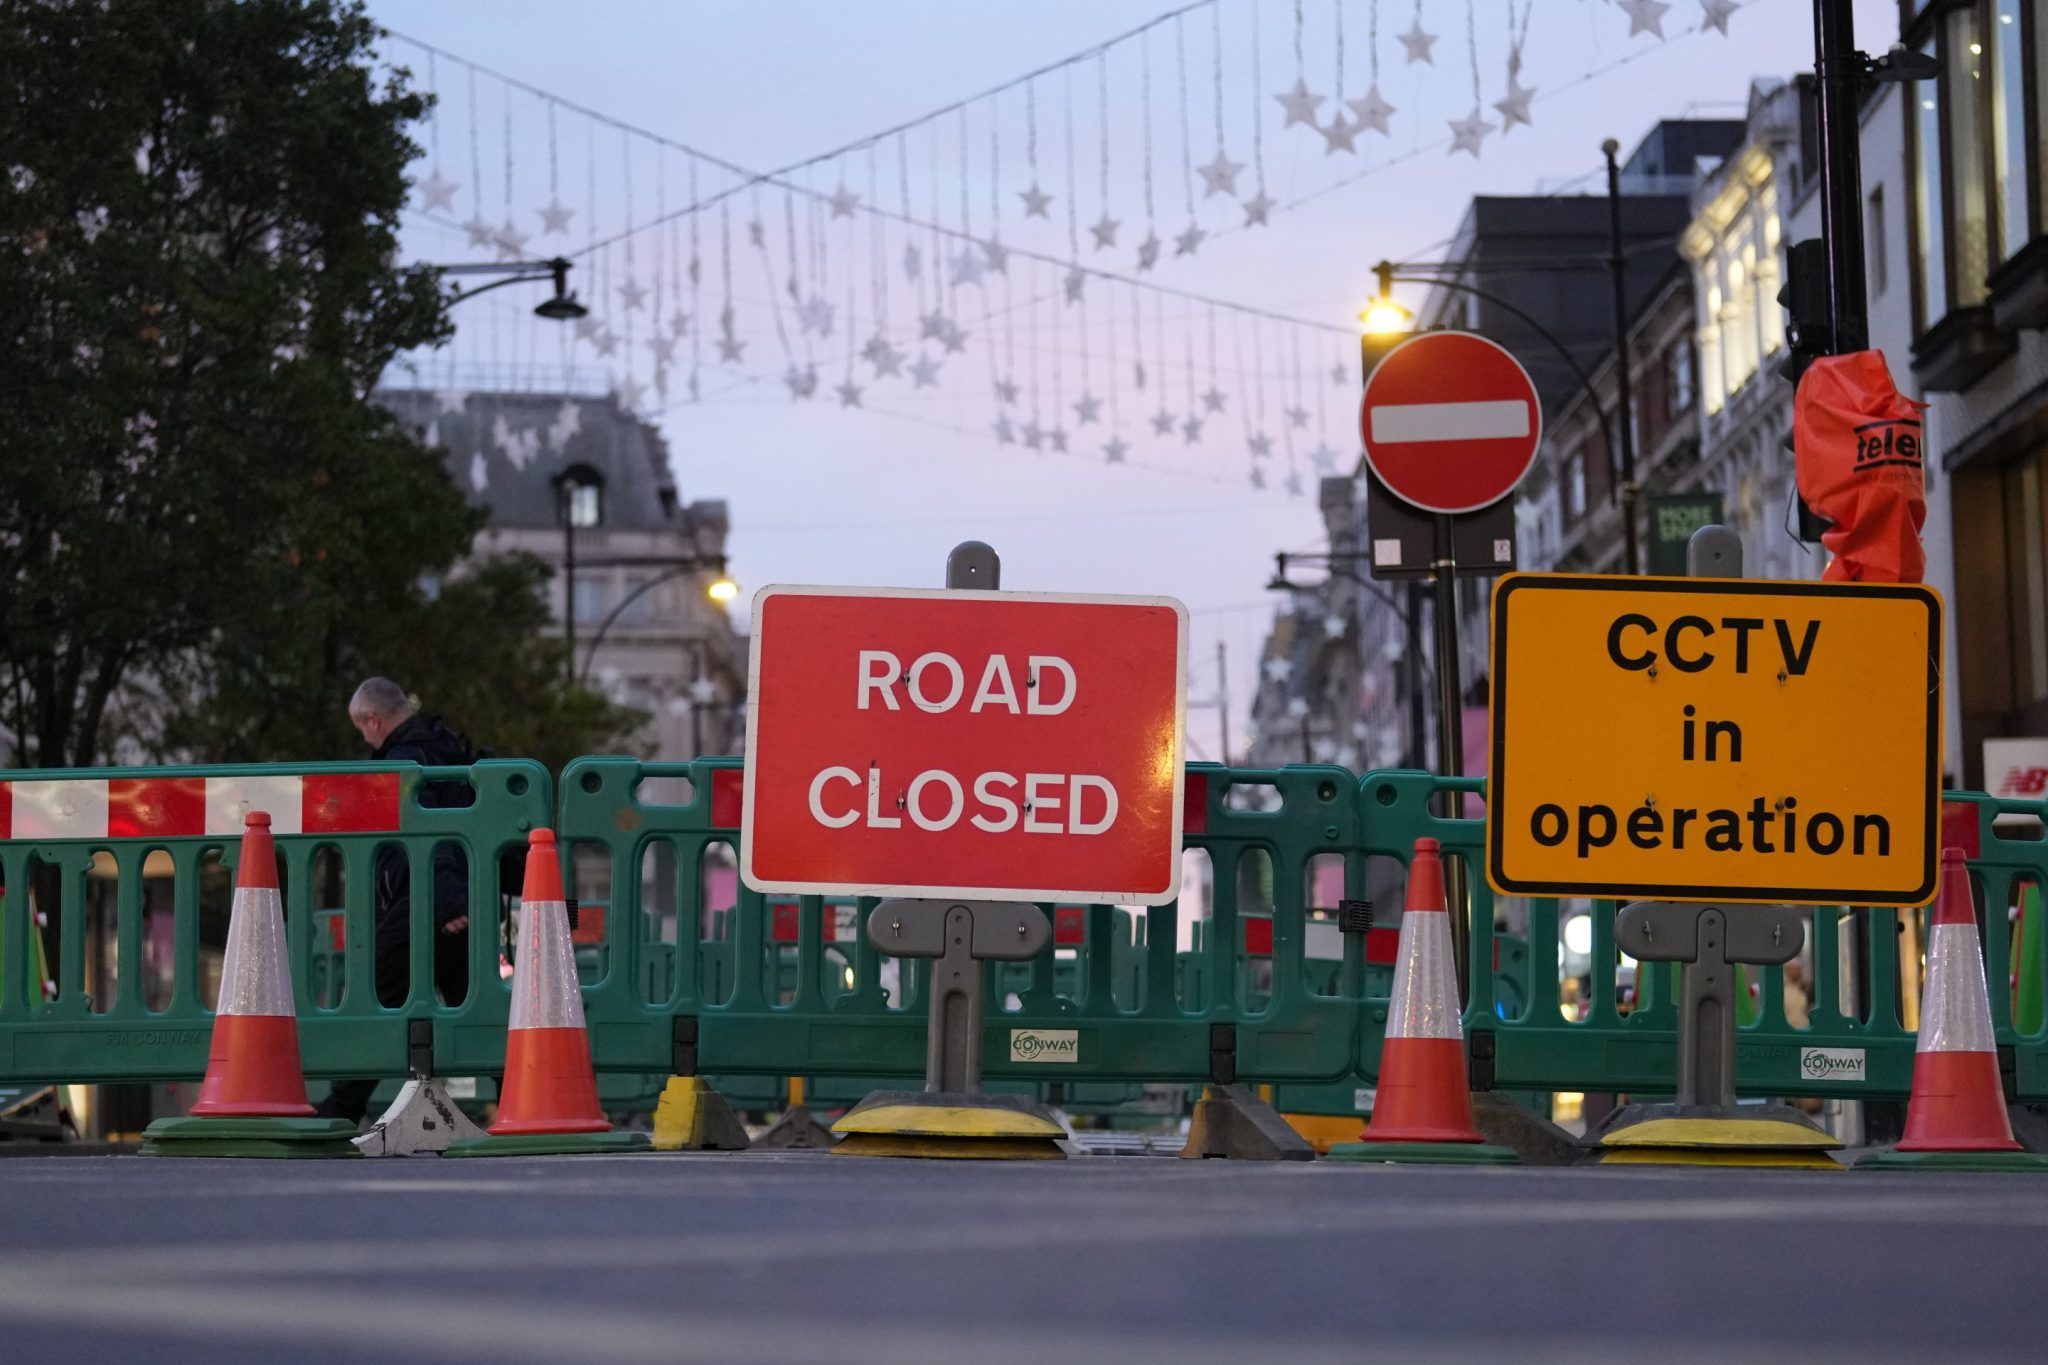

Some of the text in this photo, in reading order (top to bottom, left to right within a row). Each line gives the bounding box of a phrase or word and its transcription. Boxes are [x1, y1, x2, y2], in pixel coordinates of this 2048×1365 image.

[1606, 613, 1822, 676] CCTV
[857, 650, 1077, 716] ROAD
[1682, 704, 1743, 762] in
[807, 766, 1119, 835] CLOSED
[1530, 796, 1890, 858] operation
[134, 1031, 201, 1046] CONWAY
[1012, 1040, 1076, 1051] CONWAY
[1736, 1045, 1792, 1059] ONWAY
[1803, 1058, 1864, 1070] CONWAY
